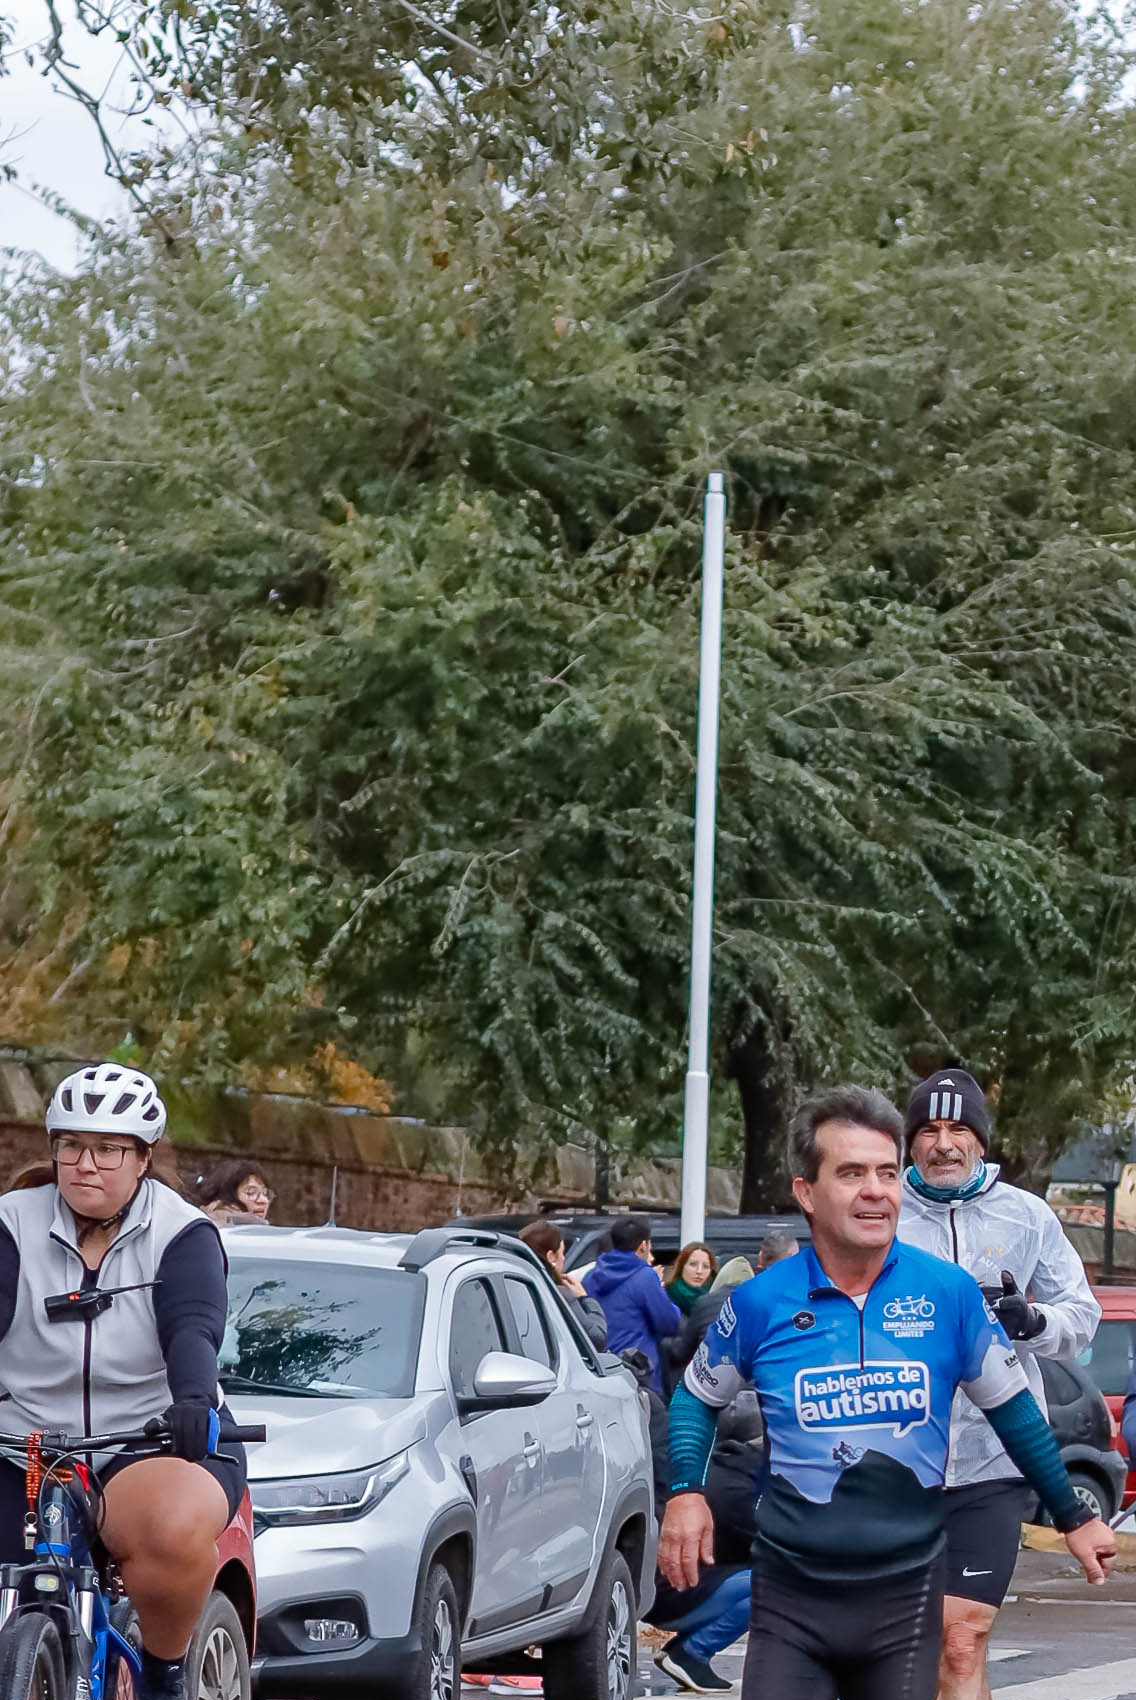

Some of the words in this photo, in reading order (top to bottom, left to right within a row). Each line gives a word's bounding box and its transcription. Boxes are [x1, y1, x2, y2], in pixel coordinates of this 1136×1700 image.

[882, 1321, 935, 1329] EMPUJANDO
[803, 1371, 895, 1397] hablemos
[897, 1364, 921, 1383] de
[800, 1387, 926, 1422] autismo
